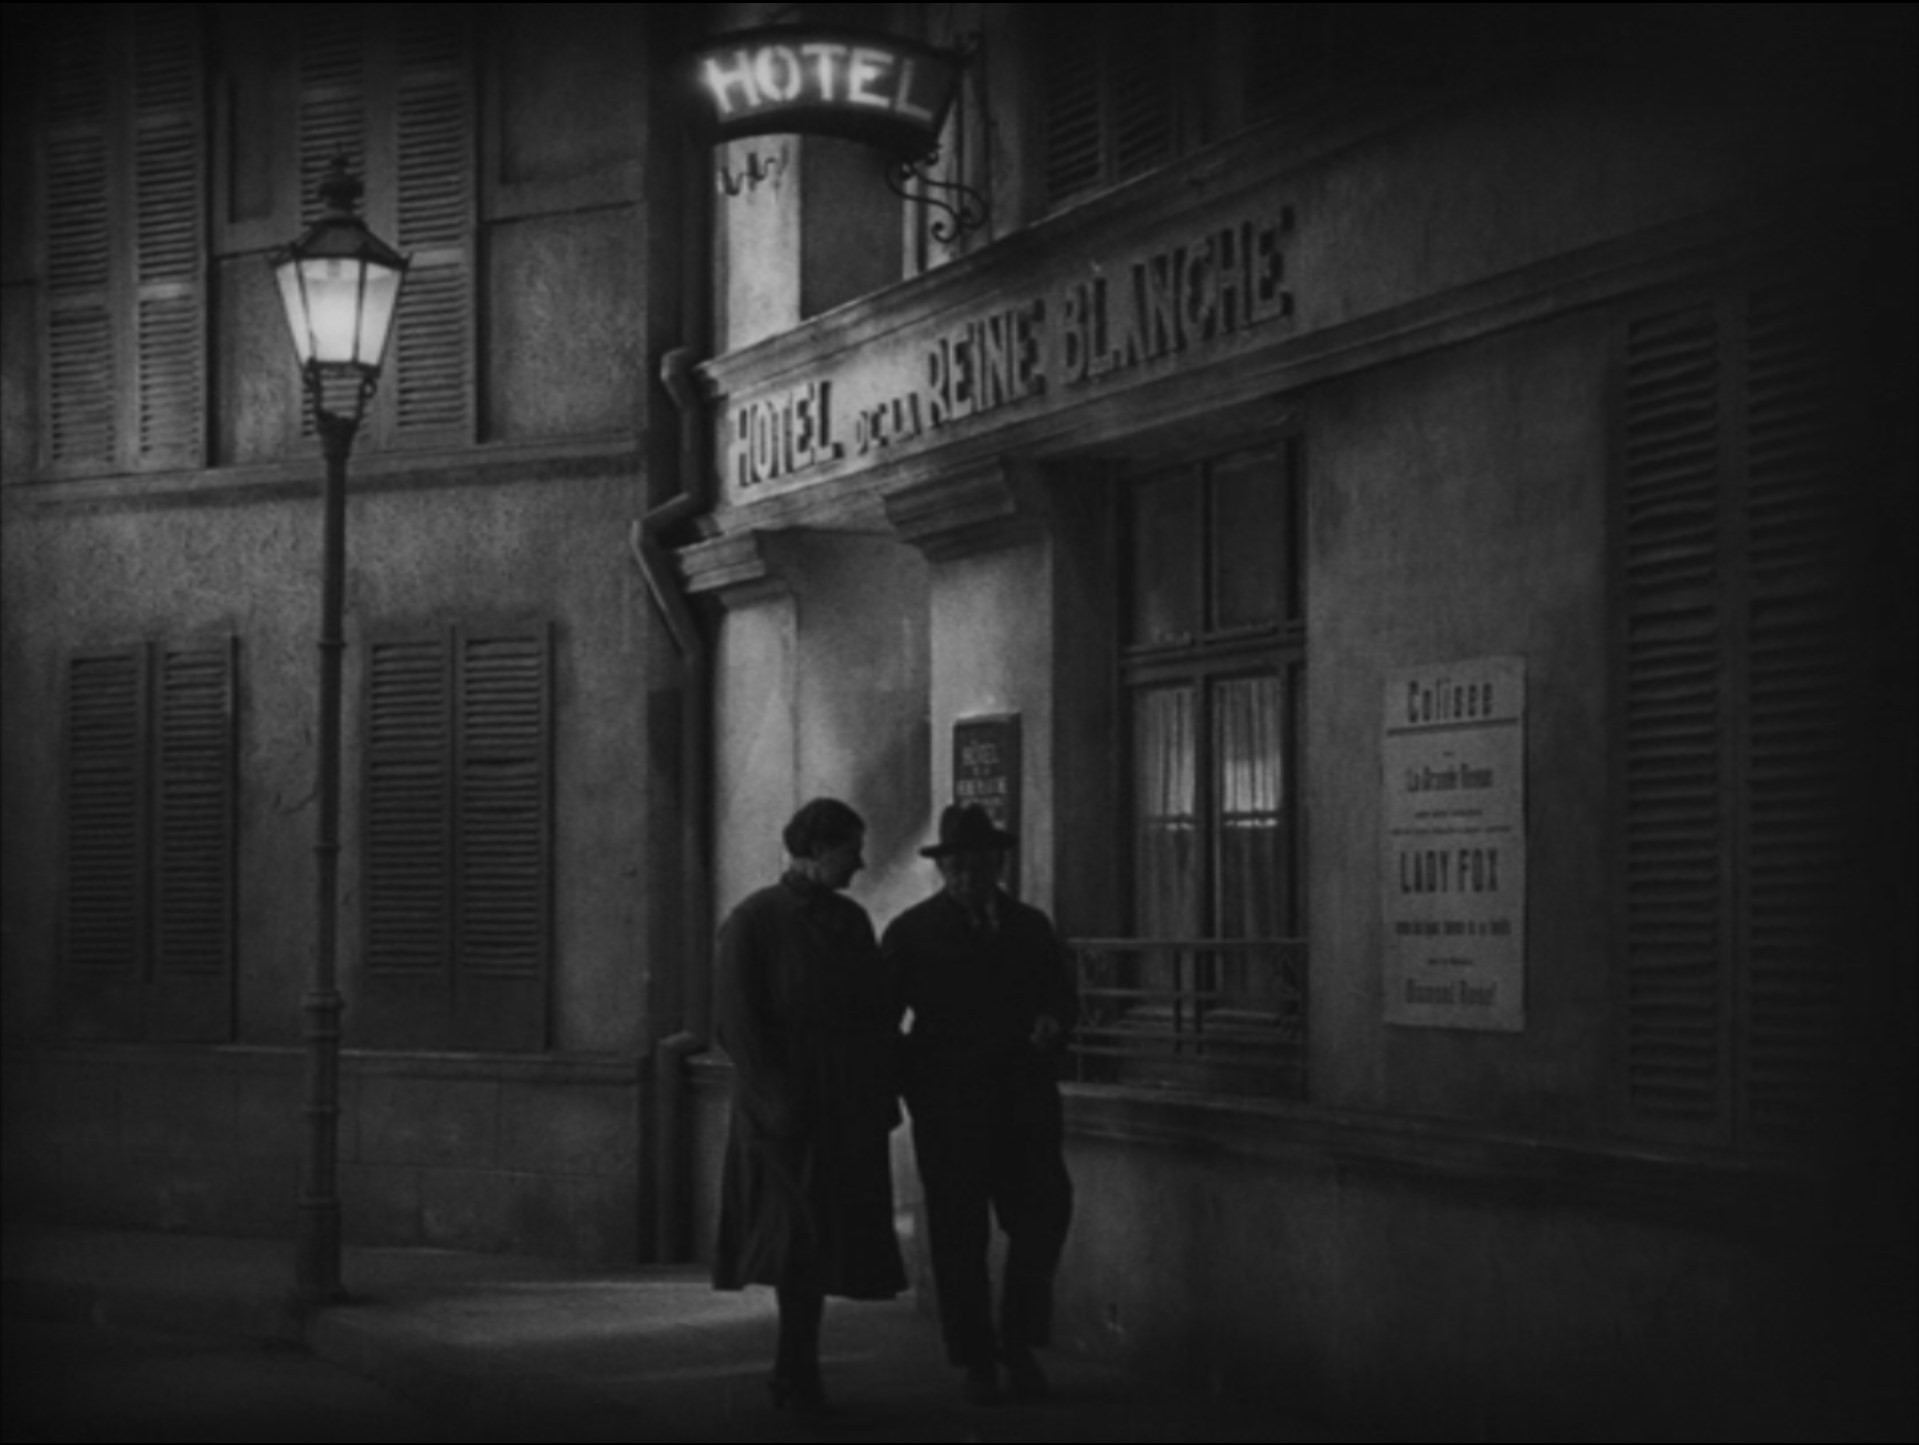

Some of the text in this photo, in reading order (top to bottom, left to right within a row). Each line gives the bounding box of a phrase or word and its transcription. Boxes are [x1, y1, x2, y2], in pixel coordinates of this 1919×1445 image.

[702, 42, 934, 115] HOTEL
[731, 380, 845, 489] HOTEL
[924, 300, 1046, 429] REINE
[1060, 205, 1296, 389] BLANCHE
[1399, 848, 1498, 894] LADY FOX
